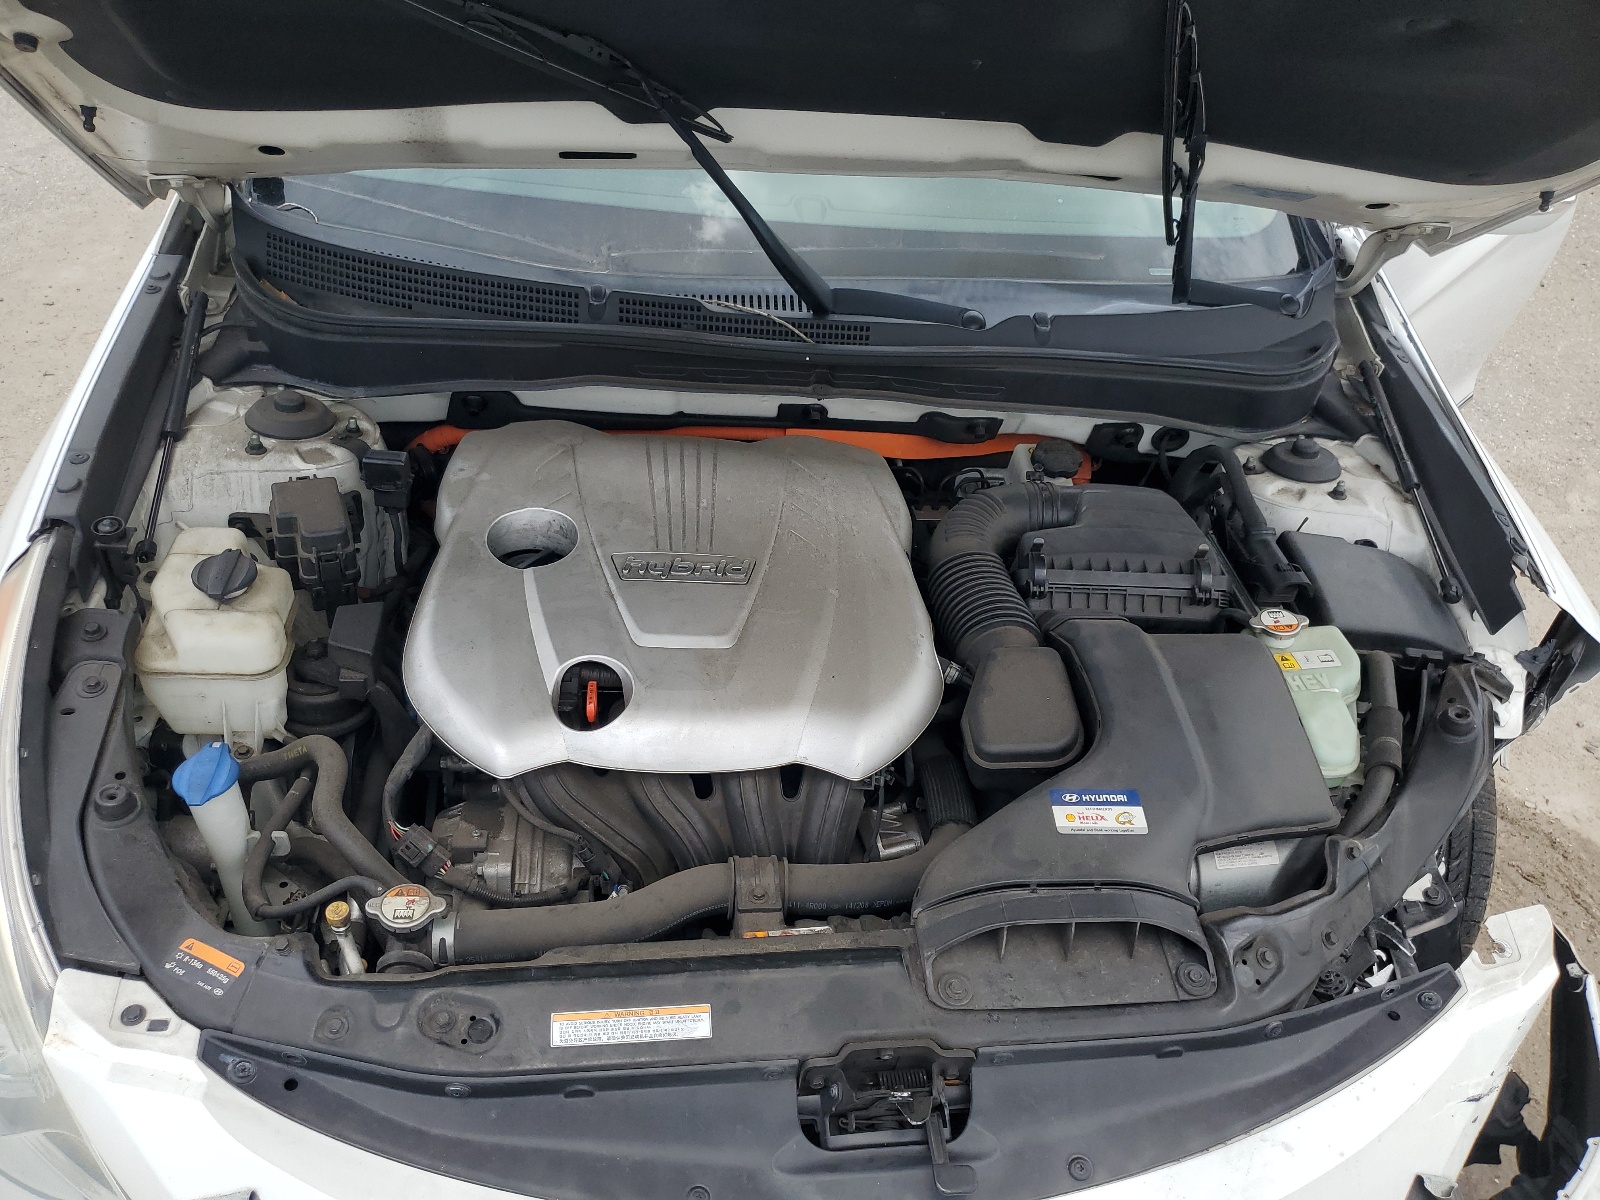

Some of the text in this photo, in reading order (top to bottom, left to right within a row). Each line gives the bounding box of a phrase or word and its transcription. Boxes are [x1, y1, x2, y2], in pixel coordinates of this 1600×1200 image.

[1286, 673, 1331, 691] HEV
[1082, 794, 1127, 802] HYUNDAI
[1078, 813, 1108, 822] HELIX
[614, 1010, 645, 1018] WARNING
